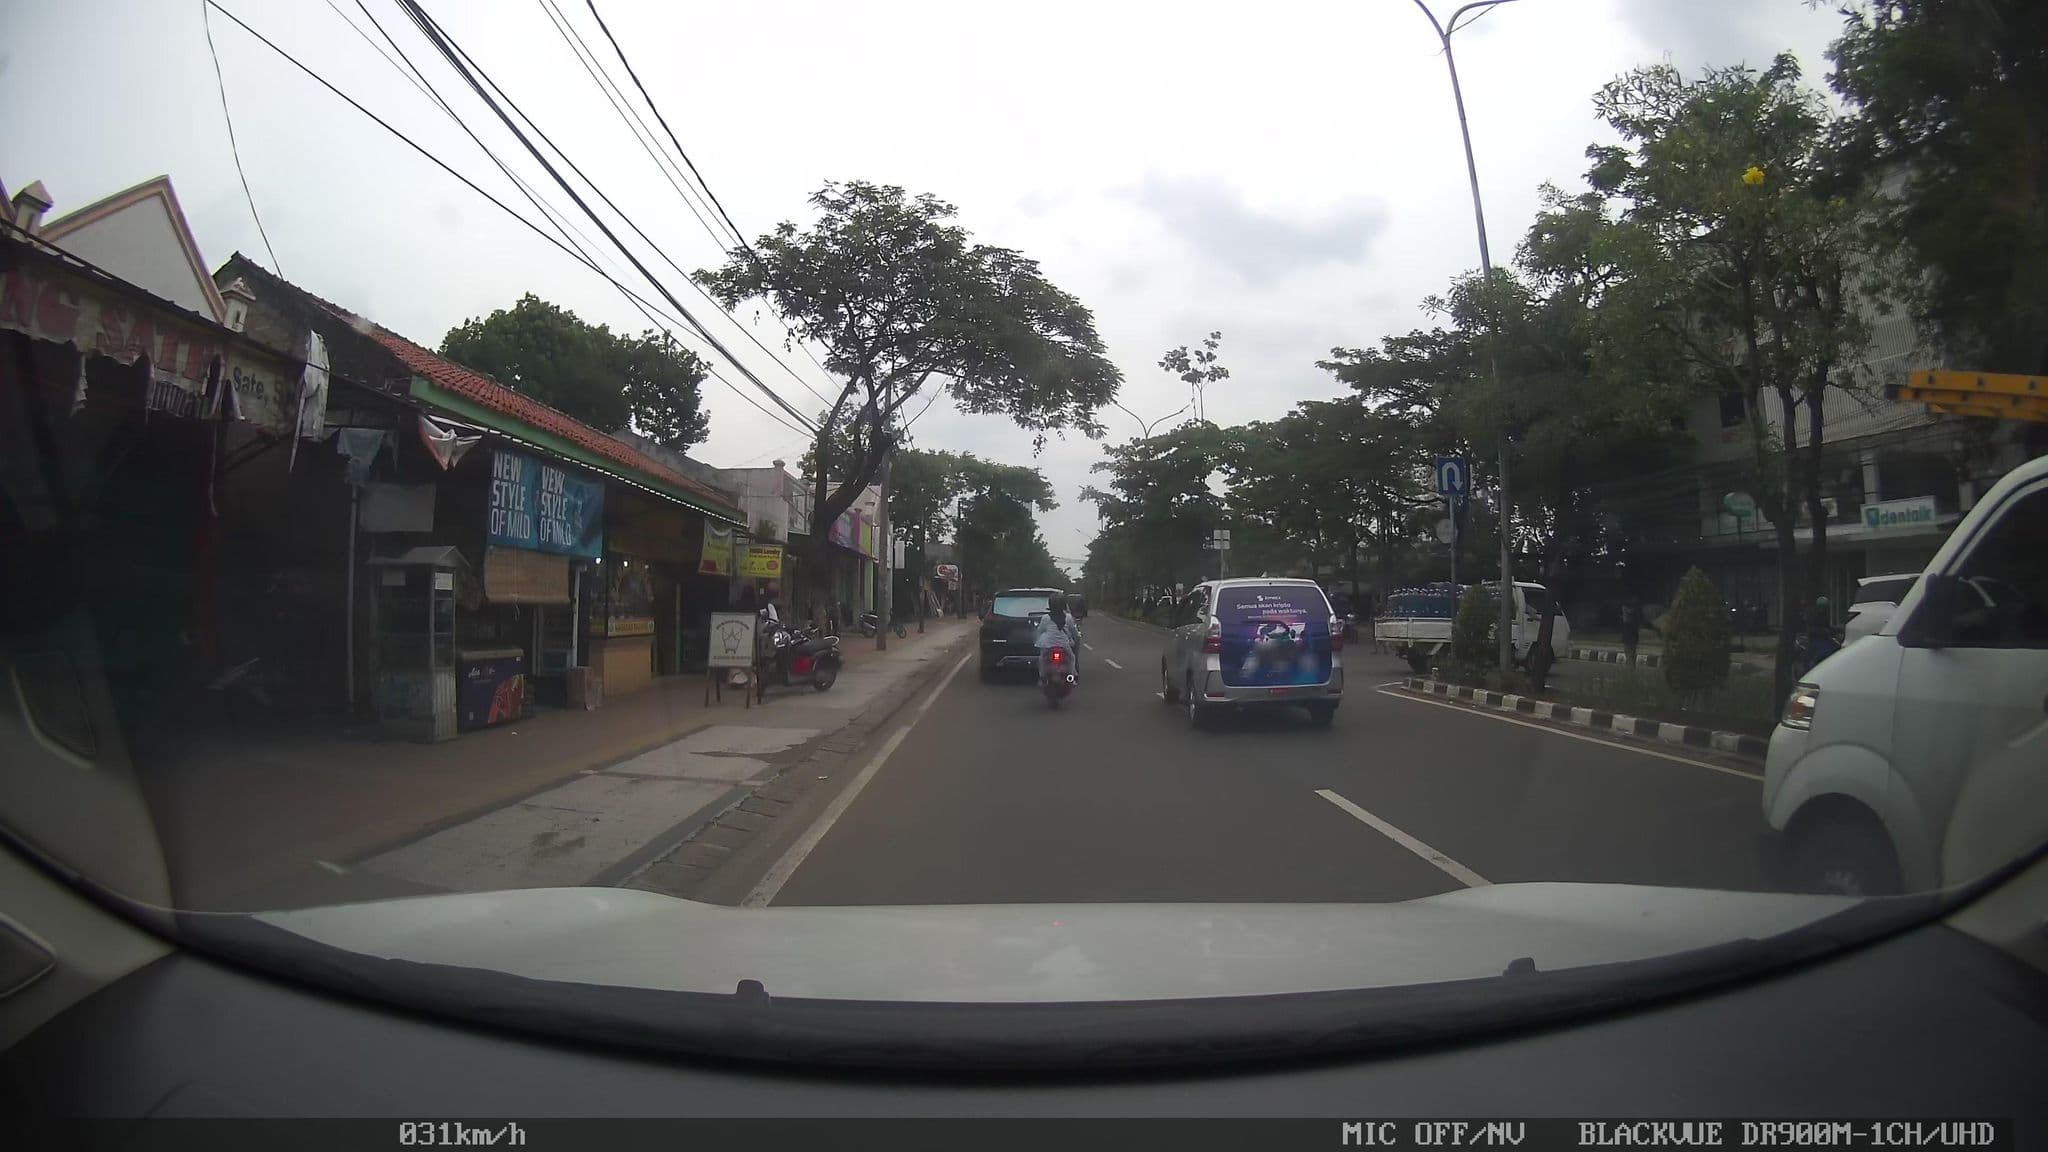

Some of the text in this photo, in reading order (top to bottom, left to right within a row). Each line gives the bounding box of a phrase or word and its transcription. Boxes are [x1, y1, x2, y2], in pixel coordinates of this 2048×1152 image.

[494, 451, 522, 483] NEW
[492, 480, 526, 511] STYLE
[541, 491, 568, 520] STYLE
[491, 508, 531, 539] OF MILD
[540, 517, 552, 542] OF
